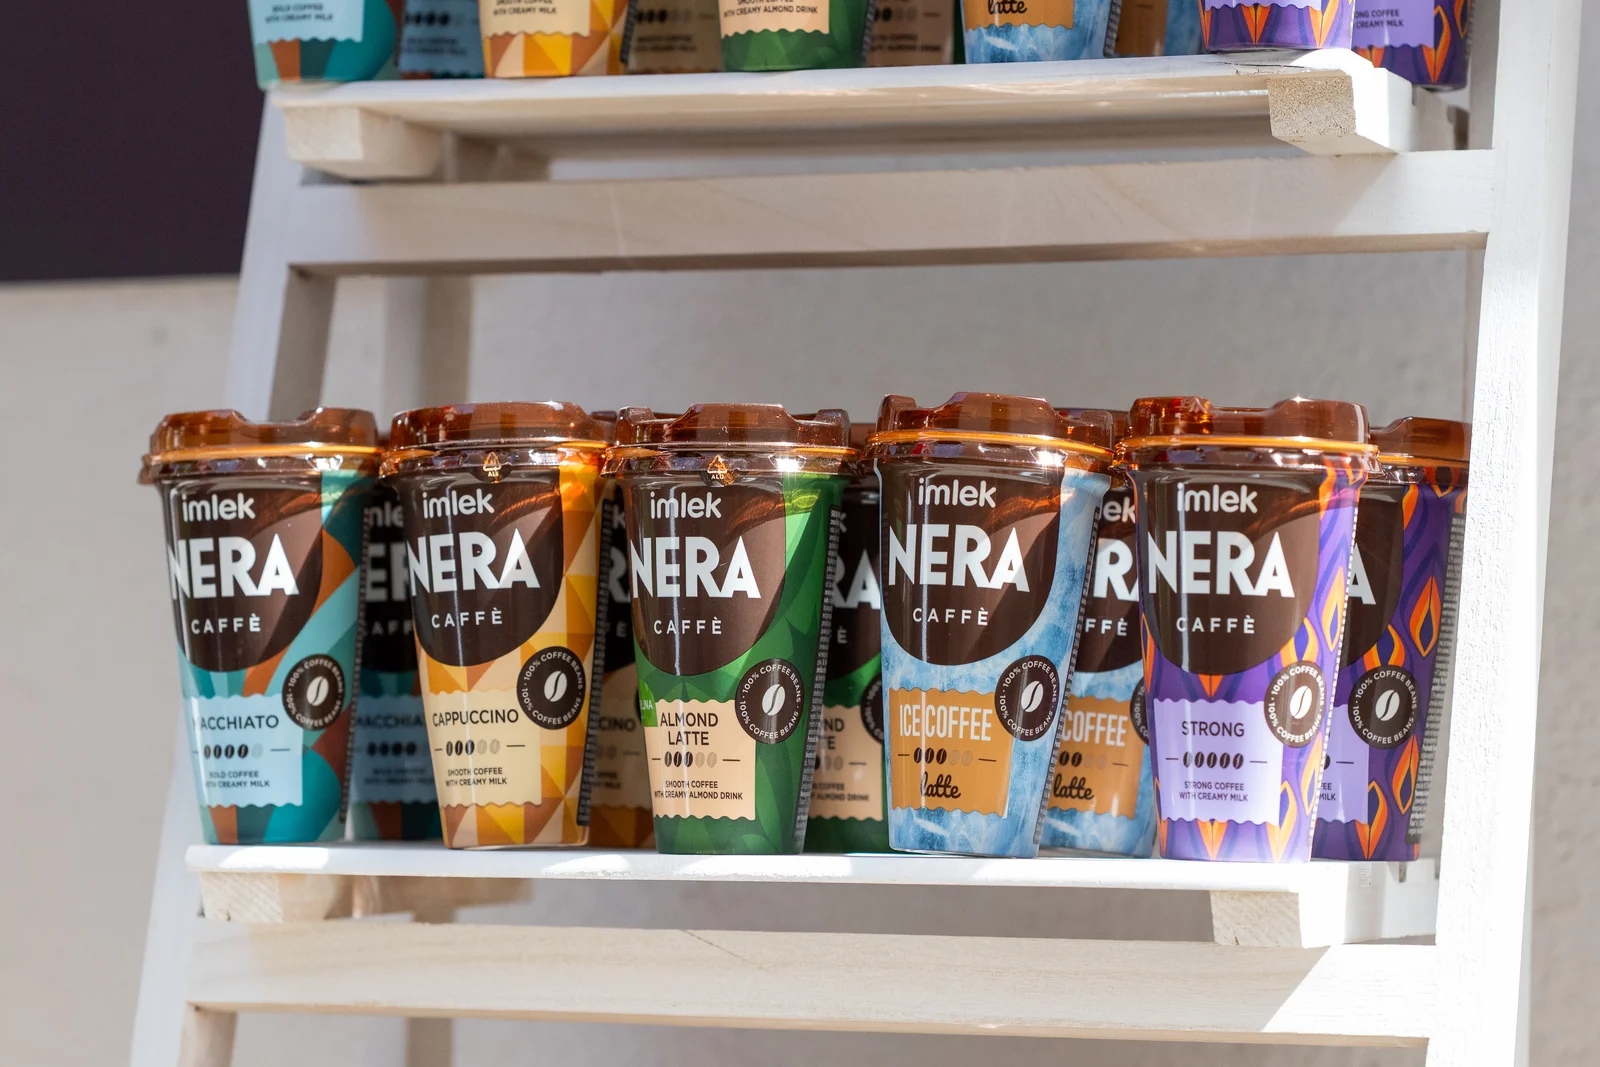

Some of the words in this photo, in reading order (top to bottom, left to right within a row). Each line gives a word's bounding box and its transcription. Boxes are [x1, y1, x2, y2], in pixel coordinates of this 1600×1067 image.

[736, 7, 761, 16] CREAMY
[796, 6, 818, 14] DRINK
[1356, 20, 1384, 28] CREAMY
[1371, 9, 1399, 17] COFFEE
[422, 488, 495, 519] imlek
[650, 491, 722, 519] imlek
[918, 477, 997, 508] imlek
[1176, 482, 1258, 514] imlek
[182, 492, 256, 522] imlek
[168, 533, 299, 600] NERA
[406, 528, 541, 597] NERA
[630, 535, 761, 599] NERA
[888, 523, 1030, 593] NERA
[1147, 530, 1296, 598] NERA
[191, 613, 261, 635] CAFFÈ
[431, 607, 502, 628] CAFFÈ
[653, 616, 722, 635] CAFFÈ
[912, 607, 989, 626] CAFFÈ
[1085, 618, 1128, 637] FFÈ
[1176, 615, 1255, 634] CAFFÈ
[524, 660, 541, 680] 100%
[541, 652, 572, 663] COFFEE
[1003, 666, 1021, 687] 100%
[1022, 660, 1051, 674] COFFEE
[742, 672, 759, 693] 100%
[760, 664, 791, 676] COFFEE
[790, 673, 801, 703] BEANS
[1271, 673, 1289, 695] 100%
[1289, 665, 1318, 678] COFFEE
[1355, 677, 1373, 698] 100%
[1373, 670, 1406, 683] COFFEE
[1405, 679, 1417, 709] BEANS
[432, 709, 519, 727] CAPPUCCINO
[522, 688, 533, 711] 100%
[532, 710, 562, 725] COFFEE
[660, 712, 719, 727] ALMOND
[740, 701, 751, 724] 100%
[749, 723, 778, 738] COFFEE
[780, 711, 799, 736] BEANS
[1000, 695, 1009, 719] 100%
[1007, 719, 1034, 736] COFFEE
[192, 714, 279, 731] ACCHIATO
[900, 704, 920, 737] ICE
[925, 704, 993, 741] COFFEE
[1061, 710, 1128, 747] COFFEE
[1181, 720, 1245, 737] STRONG
[1268, 702, 1279, 727] 100%
[1276, 726, 1304, 743] COFFEE
[1353, 706, 1364, 729] 100%
[1362, 728, 1392, 744] COFFEE
[1393, 717, 1415, 742] BEANS
[668, 731, 709, 746] LATTE
[218, 781, 248, 789] CREAMY
[250, 780, 270, 788] MILK
[228, 770, 259, 779] COFFEE
[448, 768, 471, 777] SMOOTH
[473, 767, 503, 775] COFFEE
[459, 778, 487, 786] CREAMY
[666, 780, 689, 788] SMOOTH
[691, 780, 718, 788] COFFEE
[921, 771, 961, 799] latte
[665, 790, 687, 799] CREAMY
[689, 791, 718, 799] ALMOND
[720, 792, 743, 800] DRINK
[1053, 773, 1094, 800] latte
[1179, 791, 1196, 800] WITH
[1197, 792, 1228, 801] CREAMY
[1230, 793, 1248, 802] MILK
[1184, 781, 1212, 790] STRONG
[1214, 782, 1244, 791] COFFEE
[1319, 793, 1336, 801] MILK
